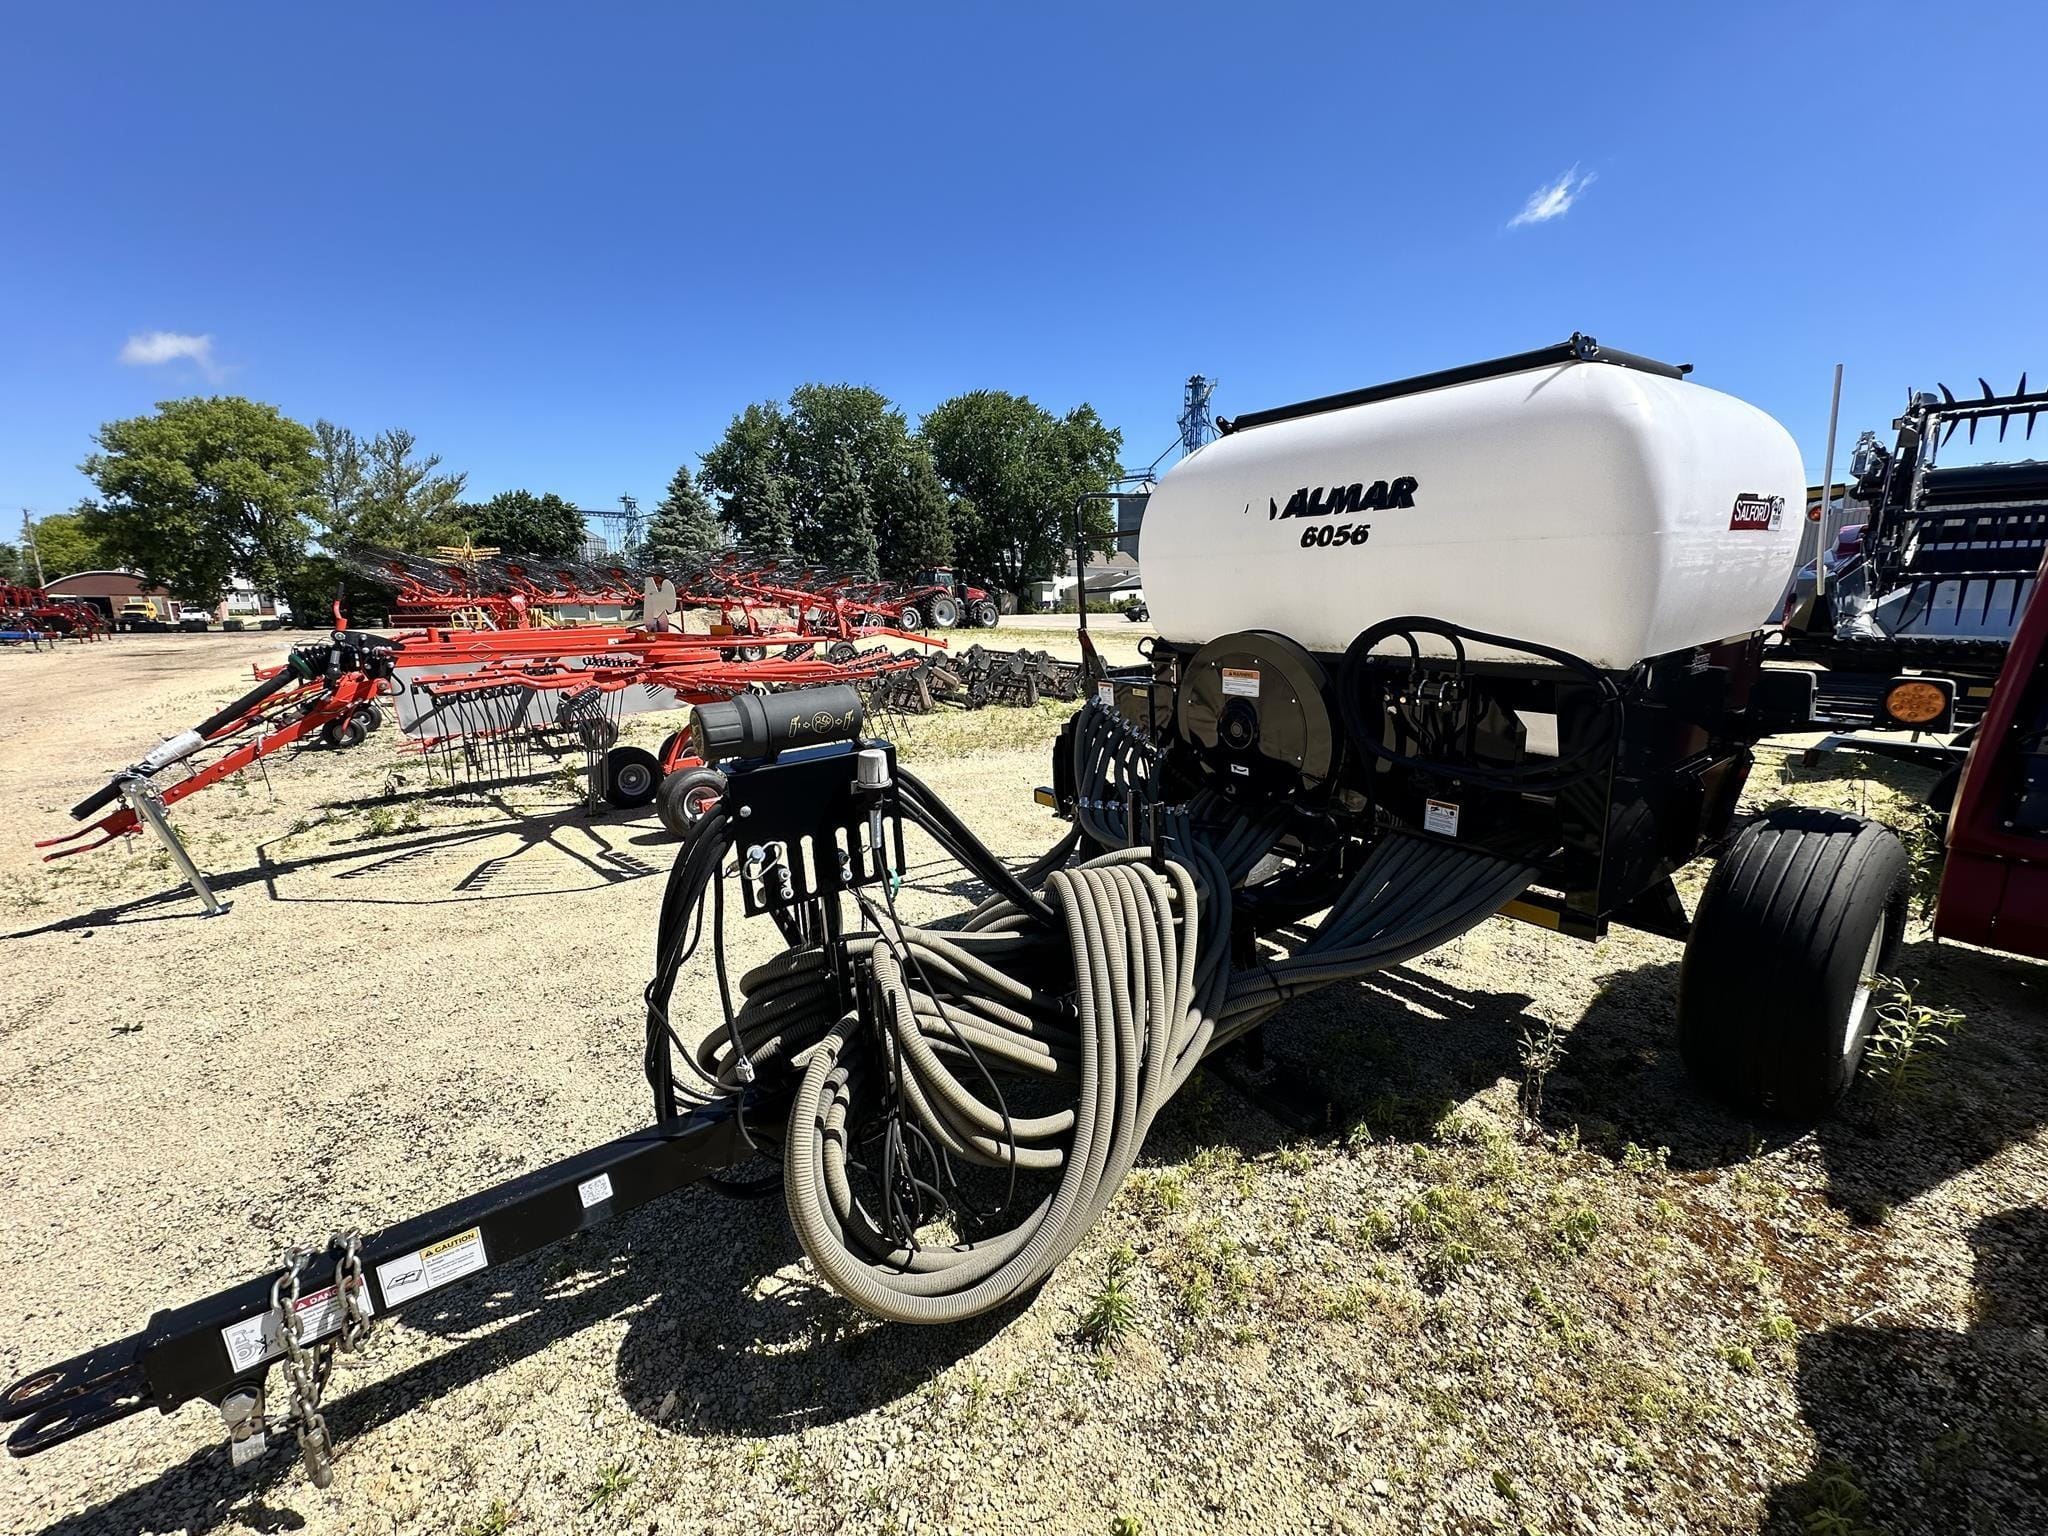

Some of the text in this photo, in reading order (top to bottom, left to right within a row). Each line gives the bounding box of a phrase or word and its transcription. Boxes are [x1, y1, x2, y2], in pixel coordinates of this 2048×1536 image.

[1734, 500, 1771, 522] SALFORD
[1300, 523, 1371, 548] 6056
[434, 1232, 475, 1253] CAUTION
